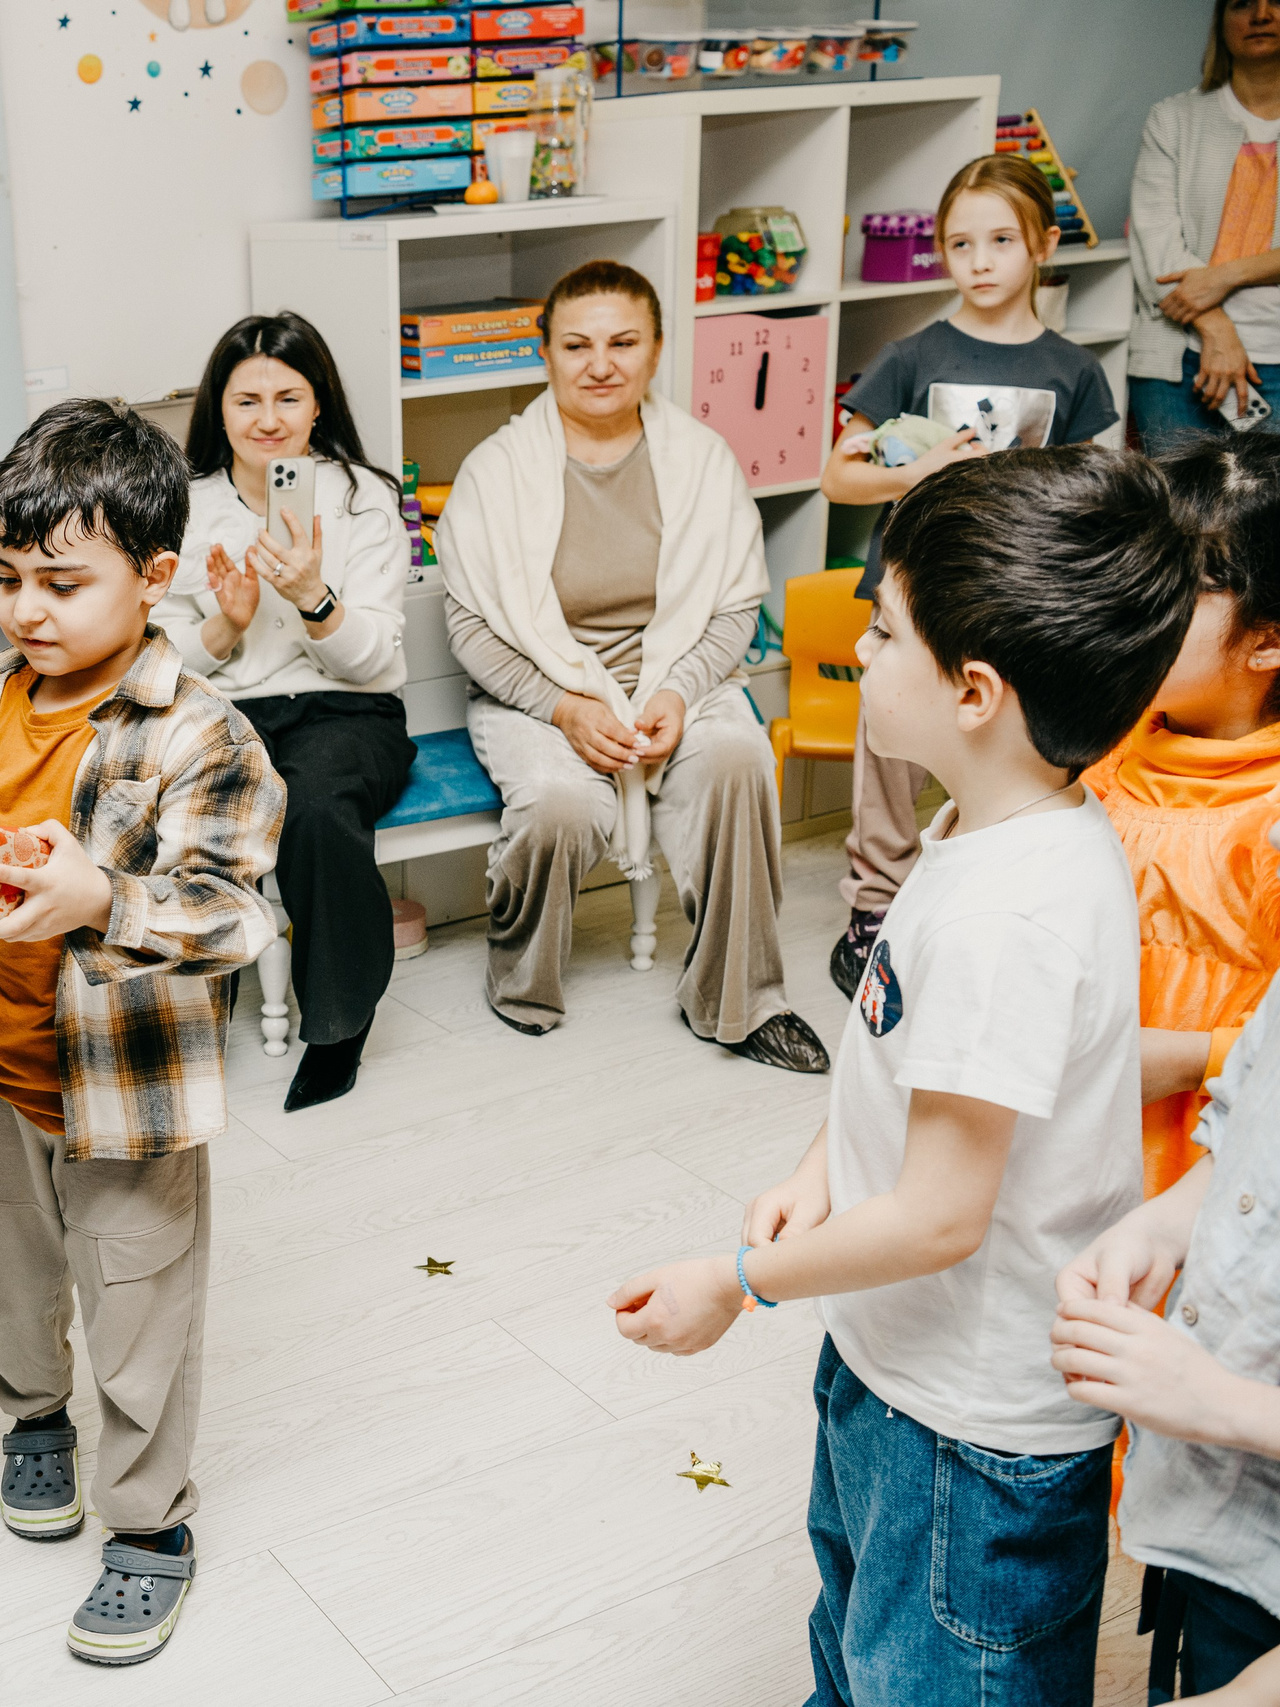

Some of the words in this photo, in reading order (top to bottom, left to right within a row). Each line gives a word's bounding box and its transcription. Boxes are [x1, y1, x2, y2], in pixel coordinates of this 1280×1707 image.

[478, 319, 509, 331] COUNT
[515, 316, 531, 328] 20
[754, 329, 770, 346] 12
[785, 335, 792, 349] 1
[453, 353, 475, 364] SPIN
[479, 348, 510, 361] COUNT
[517, 345, 534, 358] 20
[730, 341, 743, 356] 11
[802, 357, 810, 372] 2
[709, 368, 724, 384] 10
[806, 388, 815, 405] 3
[701, 402, 710, 418] 9
[797, 425, 805, 438] 4
[778, 449, 786, 464] 5
[751, 460, 760, 476] 6
